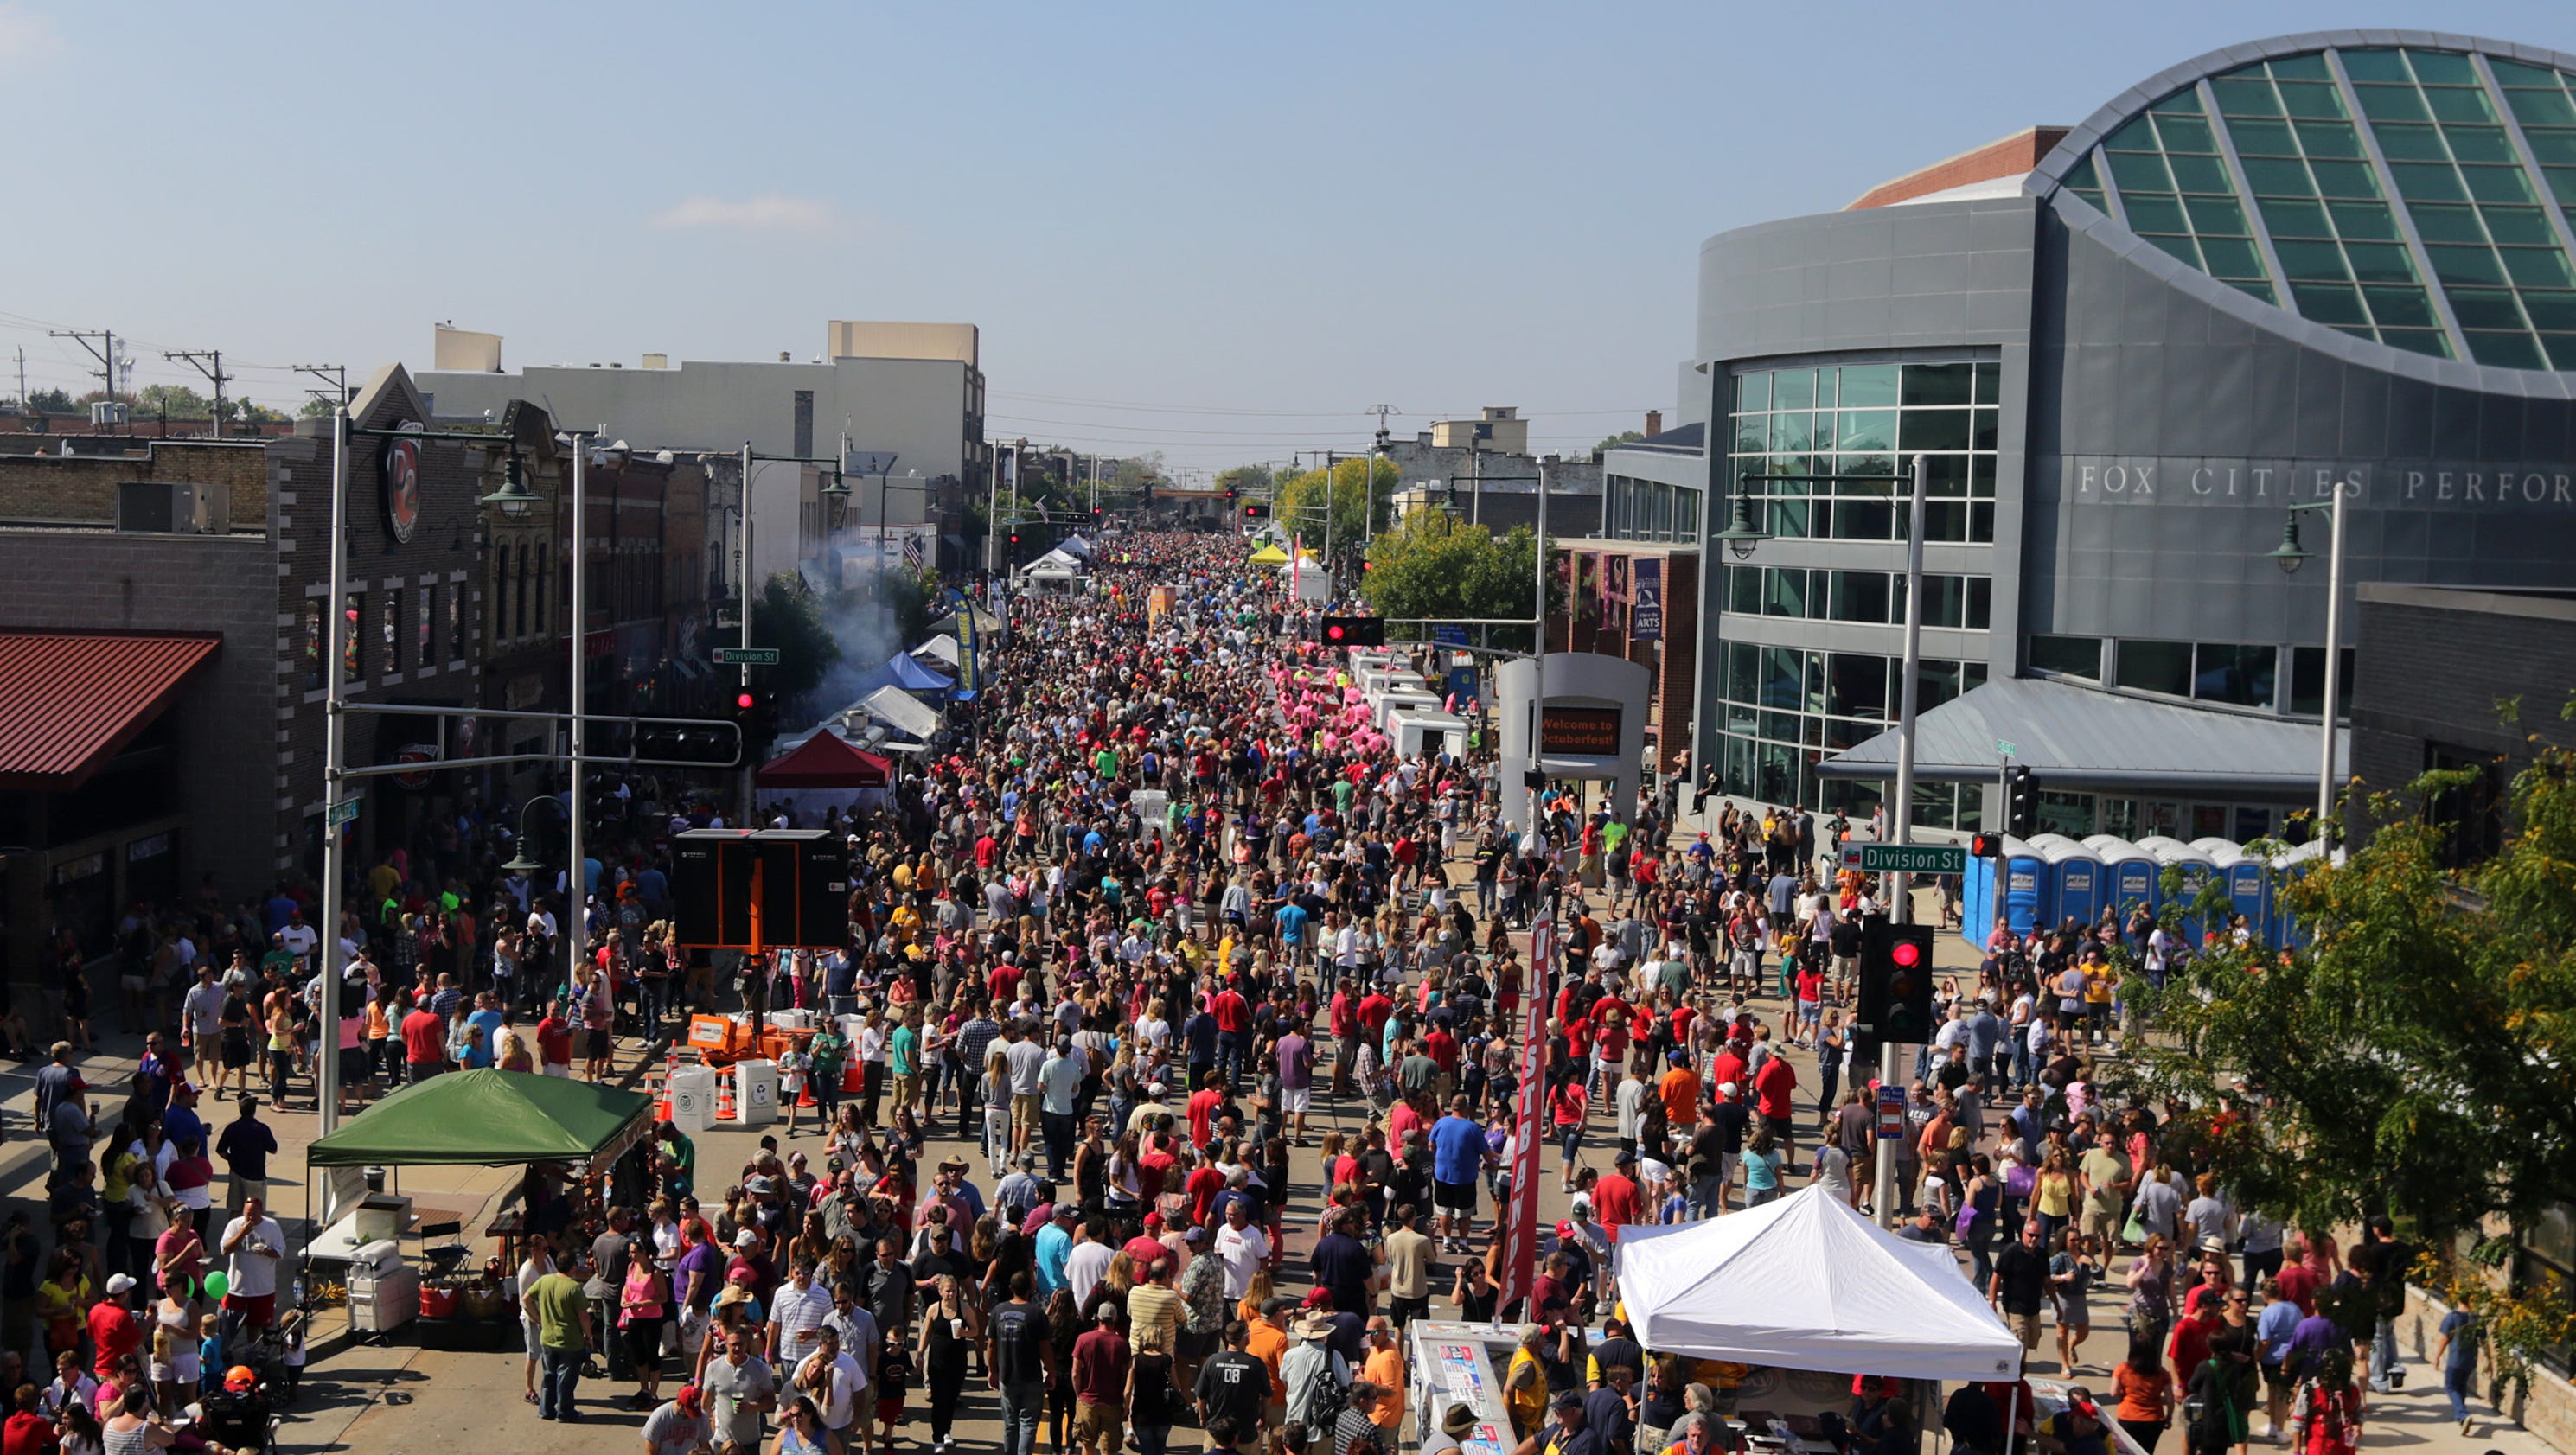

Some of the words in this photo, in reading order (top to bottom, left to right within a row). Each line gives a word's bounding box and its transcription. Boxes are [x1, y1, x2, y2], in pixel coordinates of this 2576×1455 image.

[2080, 465, 2153, 495] FOX
[2191, 468, 2362, 498] CITIES
[2407, 471, 2573, 502] PERFOR
[1637, 617, 1660, 628] ARTS
[725, 651, 763, 661] Division
[764, 652, 775, 662] St
[1542, 718, 1597, 730] Welcome
[1600, 721, 1613, 731] to
[1867, 849, 1936, 868] Division
[1941, 851, 1960, 870] St
[1908, 1109, 1930, 1120] AERO
[1224, 1369, 1241, 1383] 08
